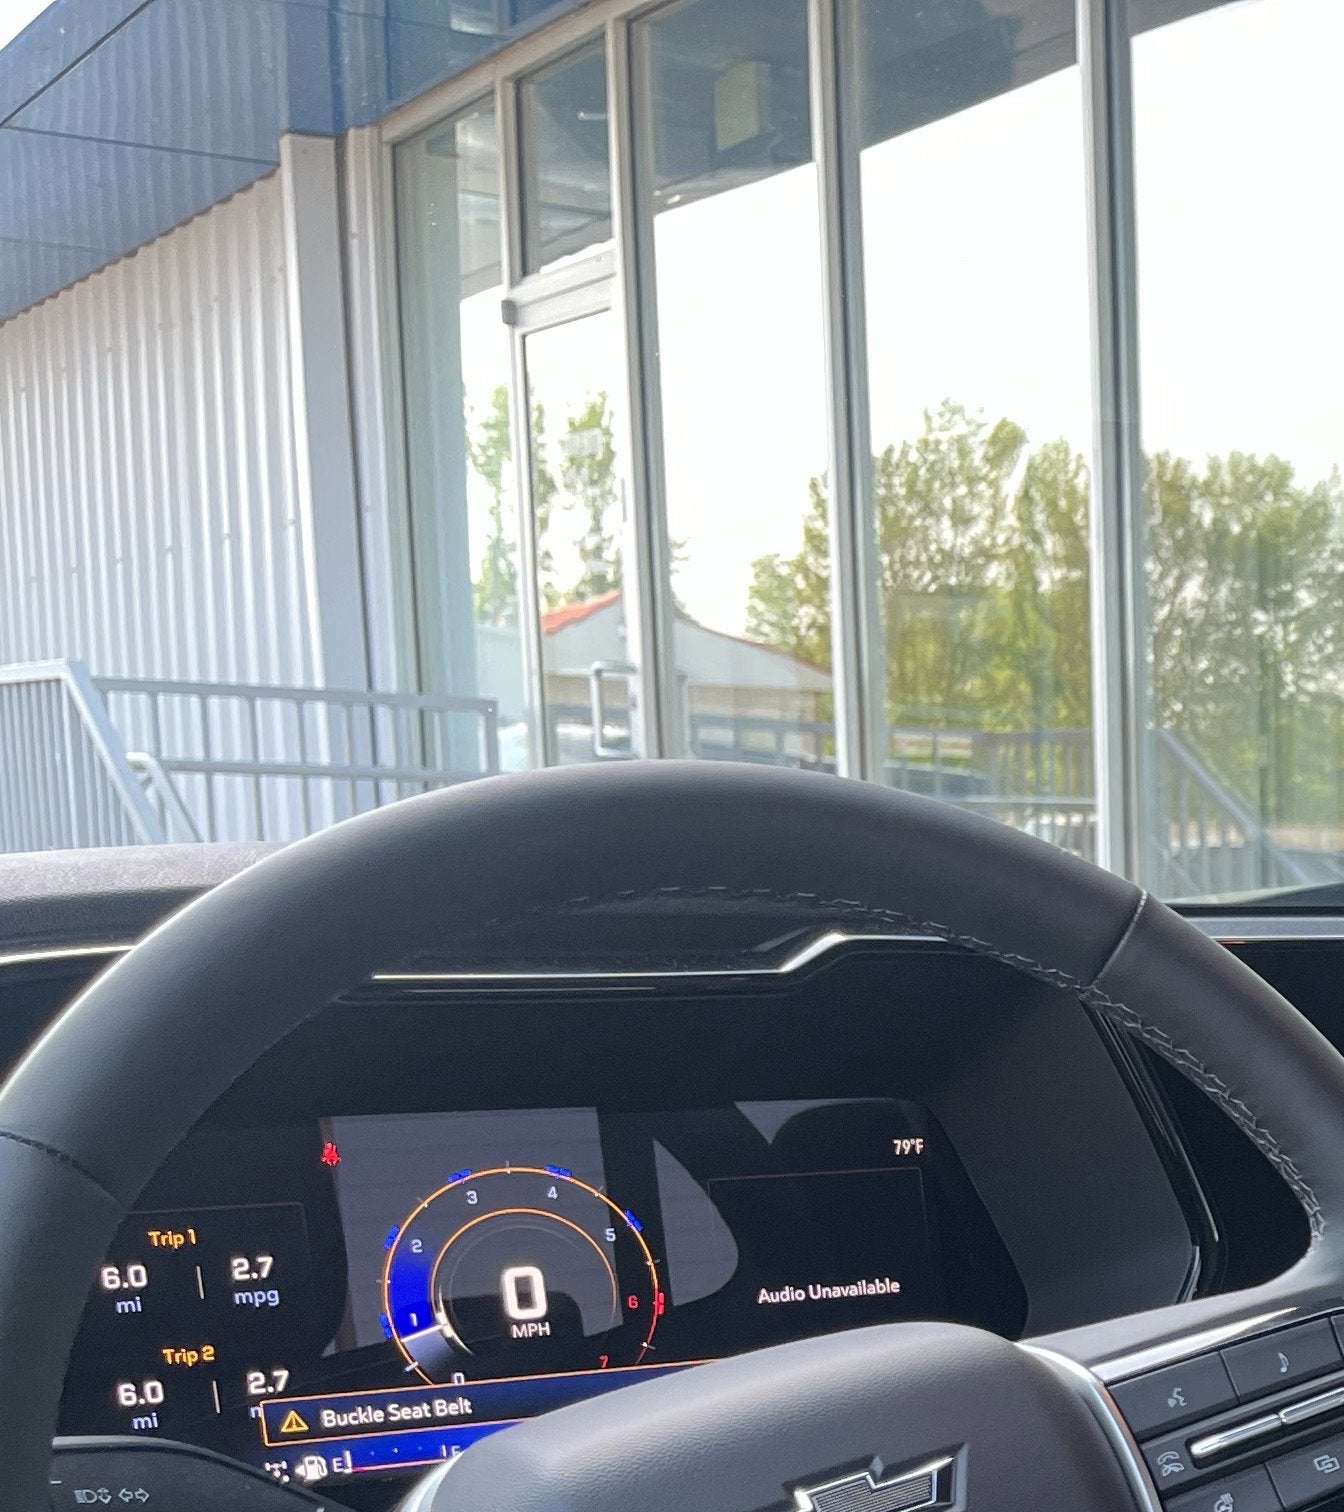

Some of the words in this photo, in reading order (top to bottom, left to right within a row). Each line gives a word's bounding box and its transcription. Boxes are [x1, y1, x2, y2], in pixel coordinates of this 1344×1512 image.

[893, 1137, 924, 1155] 79°F
[466, 1190, 478, 1205] 3
[547, 1186, 558, 1200] 4
[148, 1230, 185, 1249] Trip
[187, 1228, 197, 1246] 1
[605, 1228, 616, 1242] 5
[411, 1239, 423, 1253] 2
[100, 1264, 149, 1290] 6.0
[230, 1255, 274, 1281] 2.7
[234, 1288, 280, 1307] mpg
[503, 1266, 548, 1319] 0
[757, 1285, 806, 1304] Audio
[808, 1277, 901, 1301] Unavailable
[116, 1296, 142, 1313] mi
[628, 1295, 639, 1309] 6
[410, 1313, 418, 1327] 1
[511, 1322, 551, 1338] MPH
[162, 1348, 198, 1366] Trip
[200, 1344, 215, 1361] 2
[246, 1369, 290, 1396] 2.7
[116, 1380, 165, 1406] 6.0
[132, 1413, 158, 1430] mi
[321, 1405, 385, 1428] Buckle
[387, 1401, 431, 1421] Seat
[434, 1398, 473, 1416] Belt
